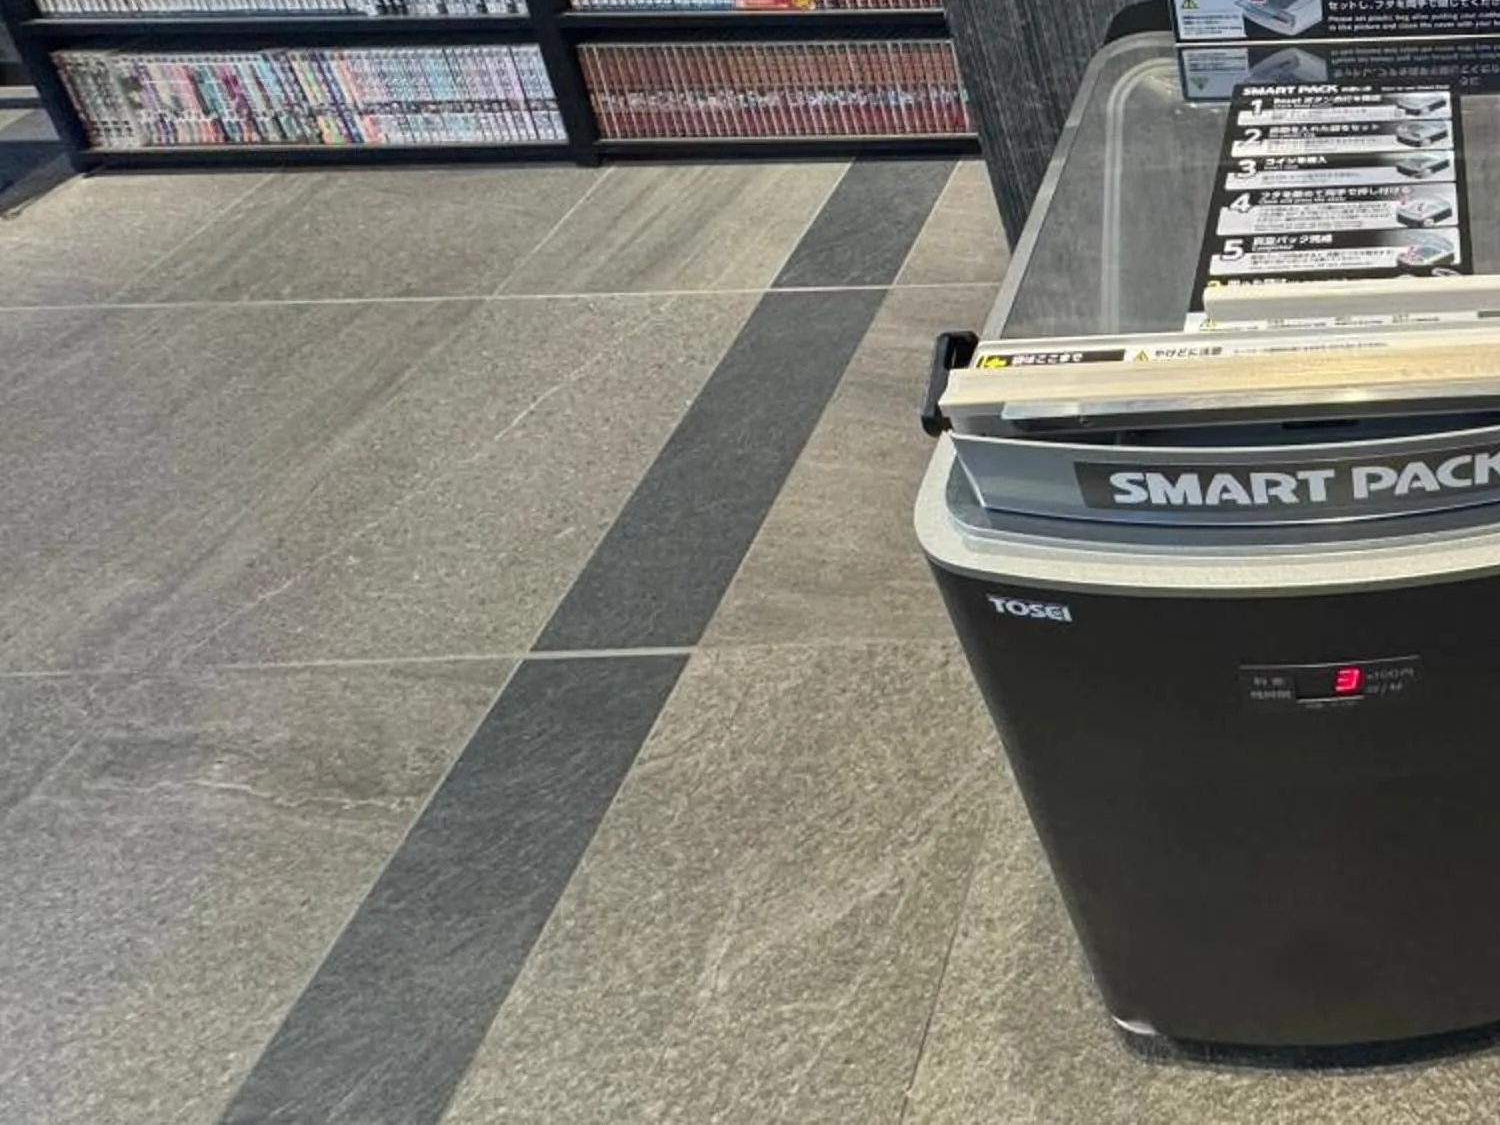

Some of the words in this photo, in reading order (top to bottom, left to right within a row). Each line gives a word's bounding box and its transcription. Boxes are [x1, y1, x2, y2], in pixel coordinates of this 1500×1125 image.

[1242, 86, 1295, 96] SMART
[1298, 84, 1338, 95] PACK
[1250, 98, 1263, 116] 1
[1244, 128, 1263, 145] 2
[1237, 159, 1257, 179] 3
[1229, 192, 1251, 213] 4
[1221, 239, 1244, 261] 5
[1109, 470, 1336, 506] SMART
[985, 594, 1073, 622] TOSEI
[1334, 667, 1361, 692] 3
